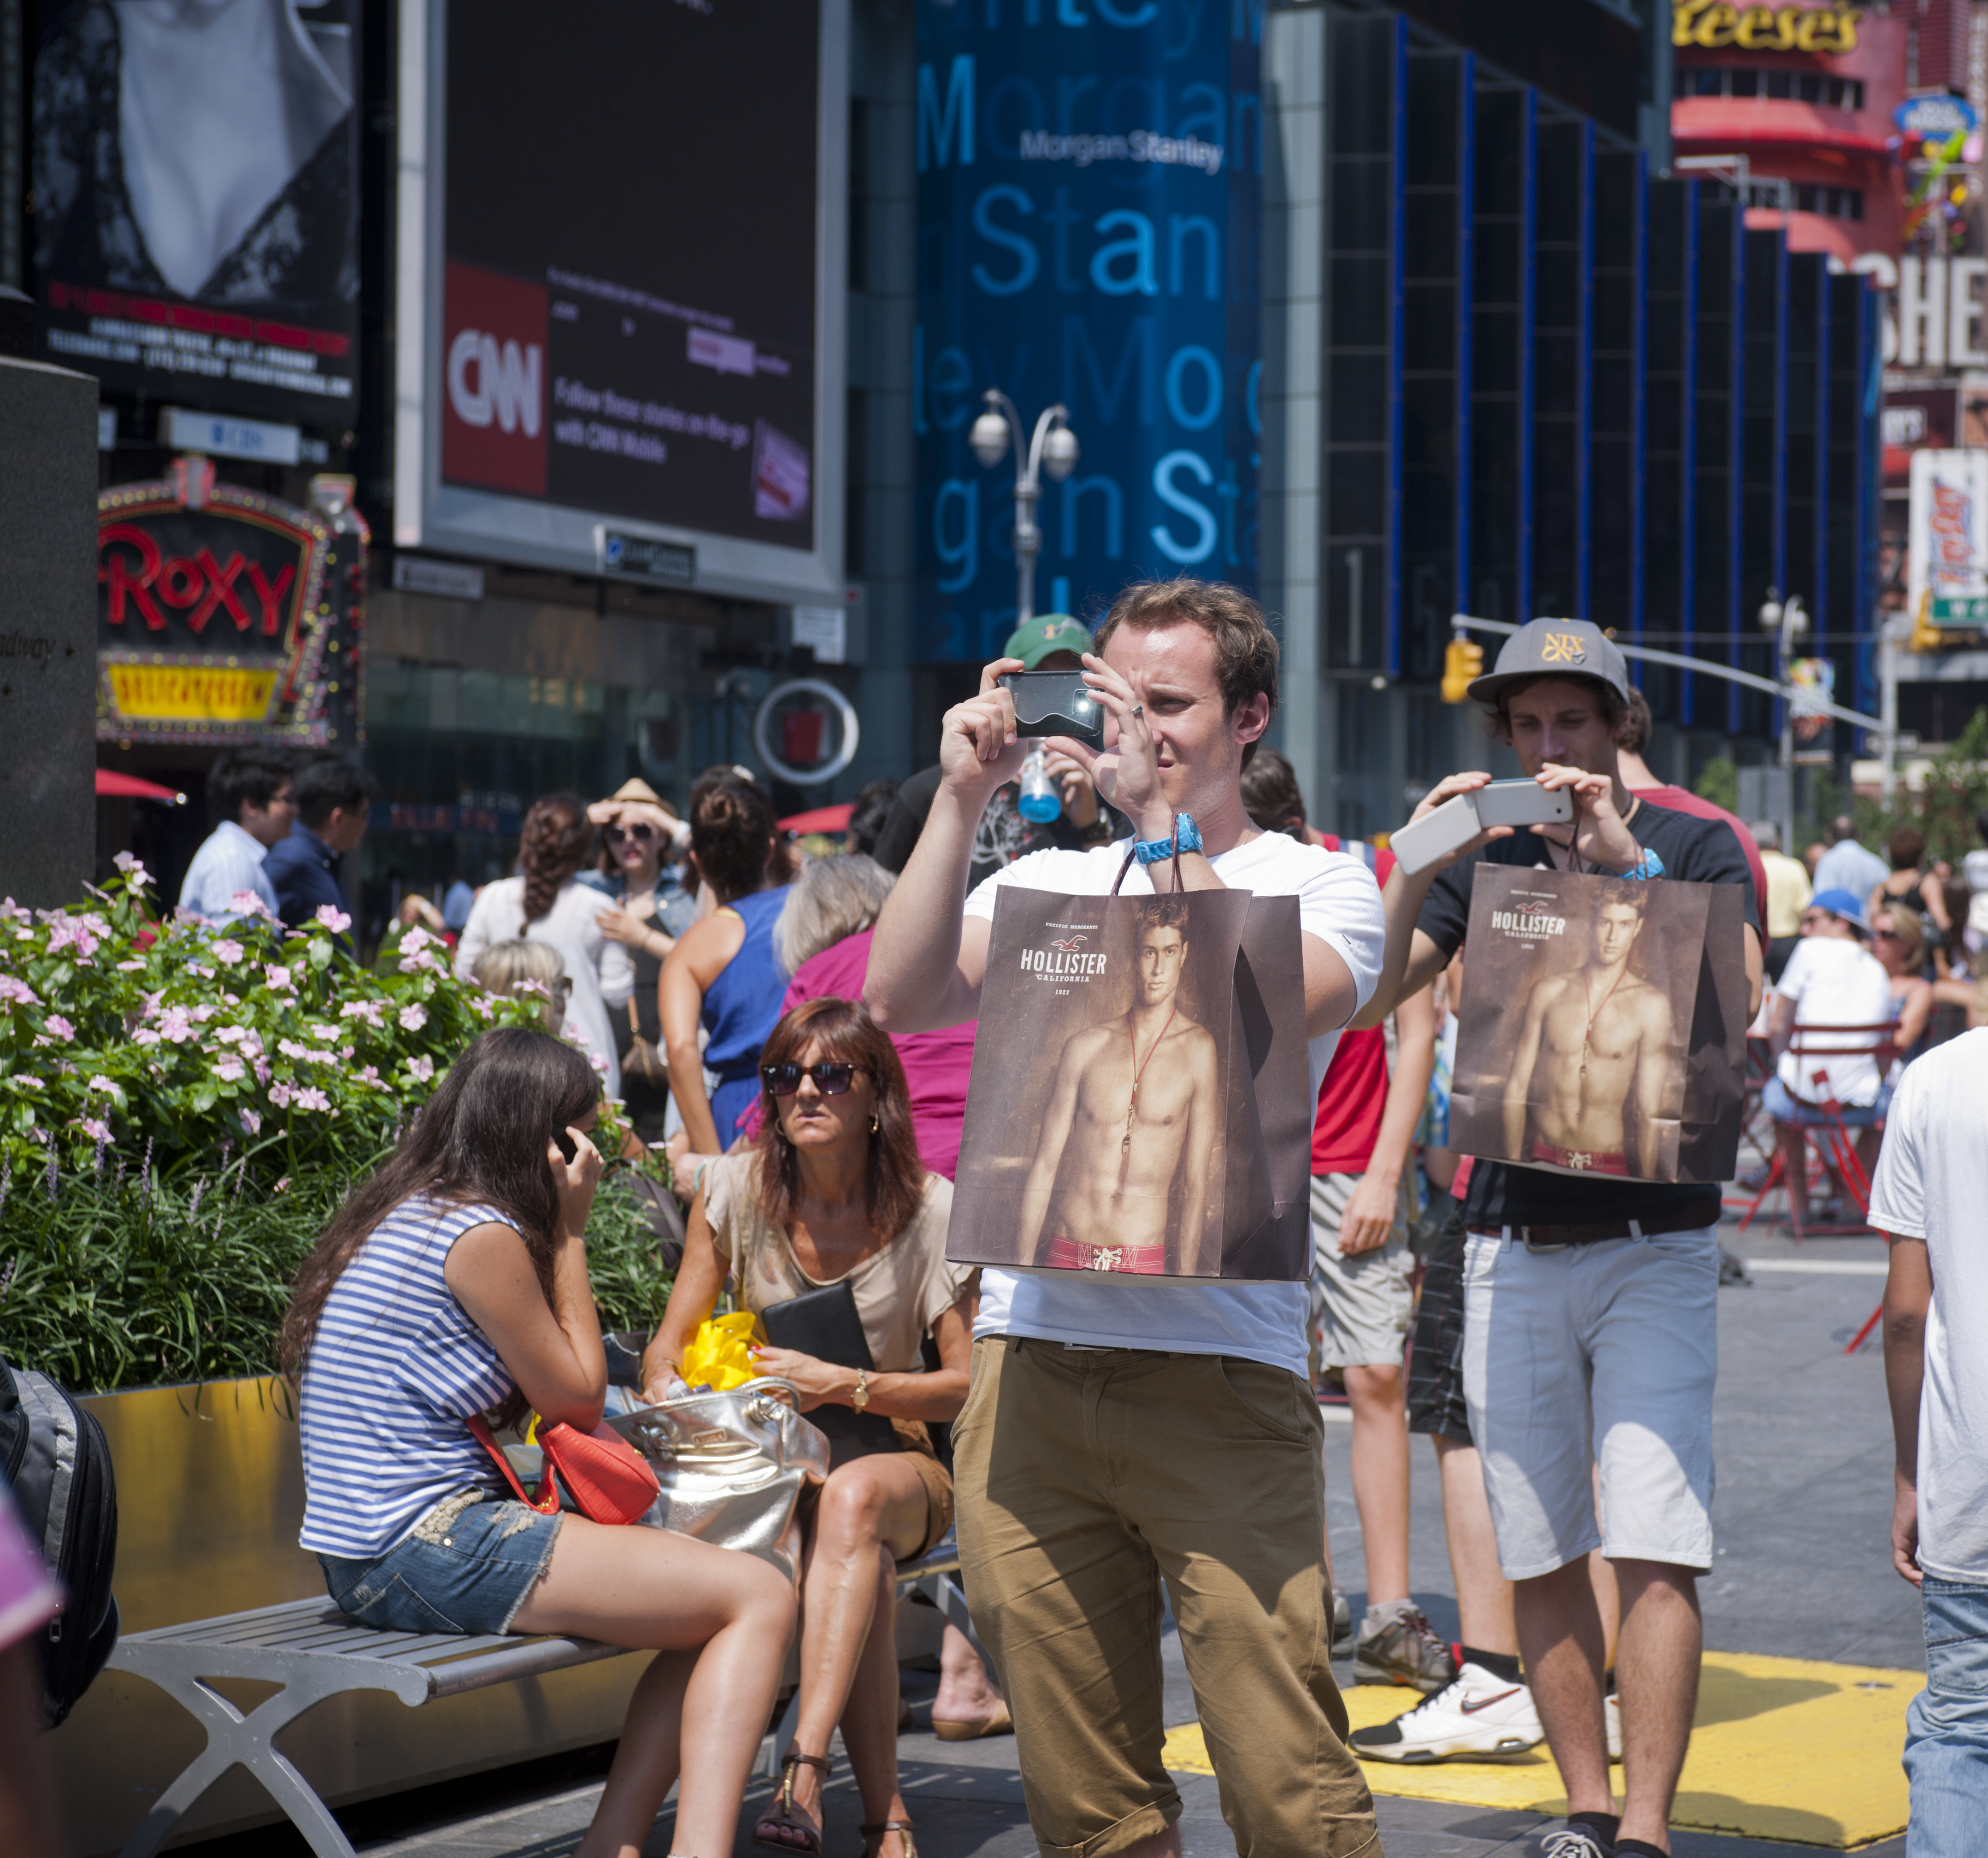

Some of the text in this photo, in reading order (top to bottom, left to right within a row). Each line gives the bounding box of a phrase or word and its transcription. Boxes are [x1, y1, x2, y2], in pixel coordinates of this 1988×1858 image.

[1020, 129, 1224, 176] Morgan Stanley
[448, 329, 543, 439] CNN
[555, 377, 600, 413] Follow
[1492, 911, 1566, 935] HOLLISTER
[1505, 930, 1549, 941] CALIFORNIA
[1020, 948, 1107, 975] HOLLISTER
[1036, 974, 1090, 982] CALIFORNIA
